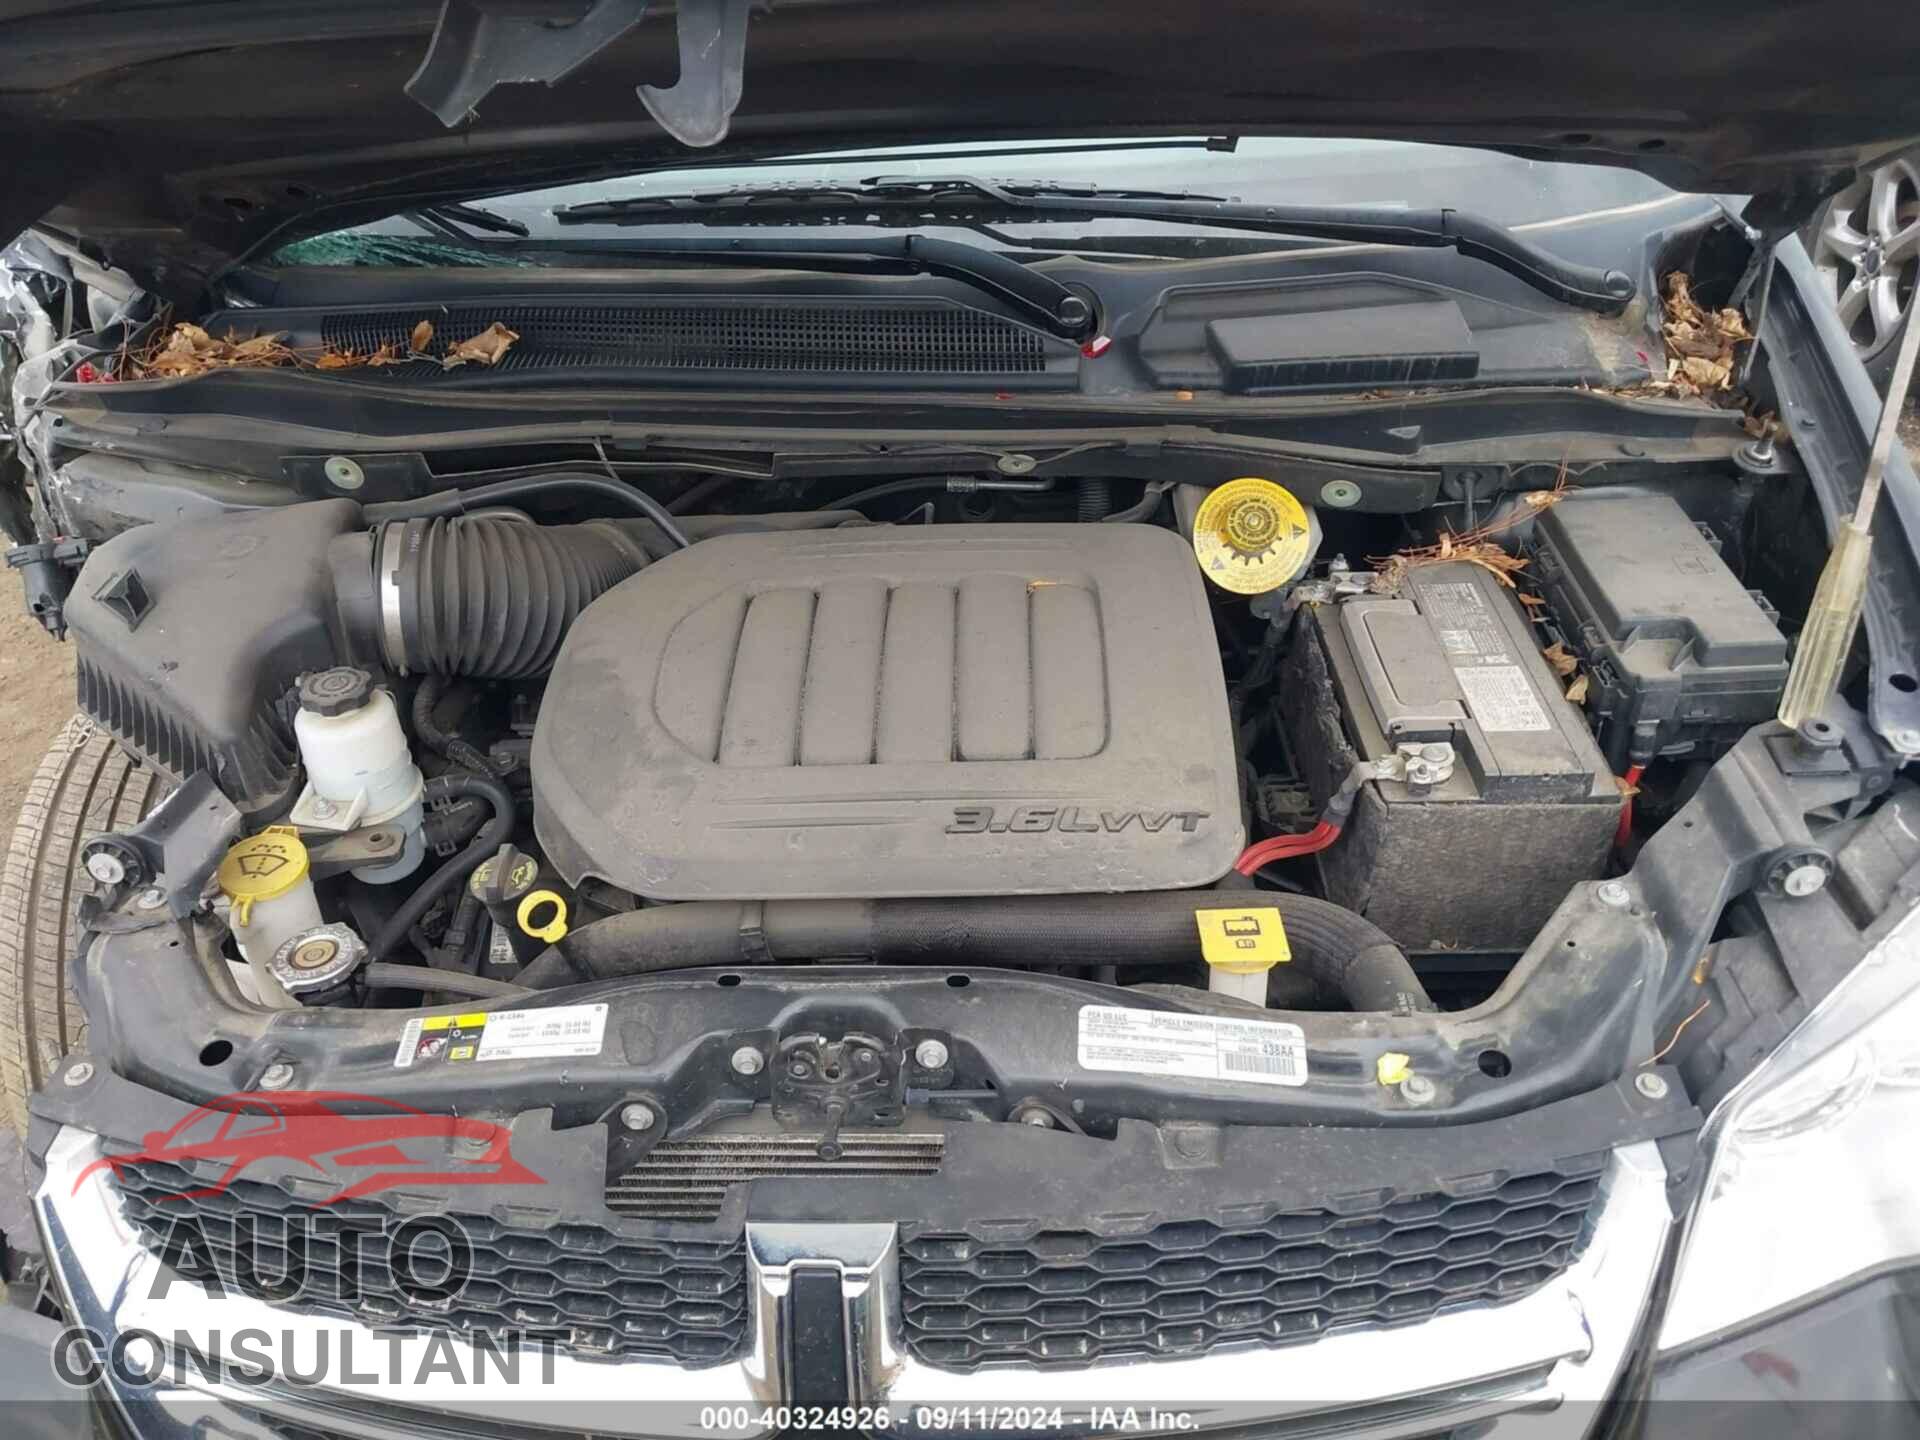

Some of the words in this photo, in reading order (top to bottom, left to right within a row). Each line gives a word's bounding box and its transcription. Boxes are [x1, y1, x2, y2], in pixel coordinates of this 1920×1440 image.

[1154, 1015, 1181, 1025] VEHICLE
[1182, 1018, 1214, 1029] EMISSION
[1262, 1042, 1294, 1057] 438AA
